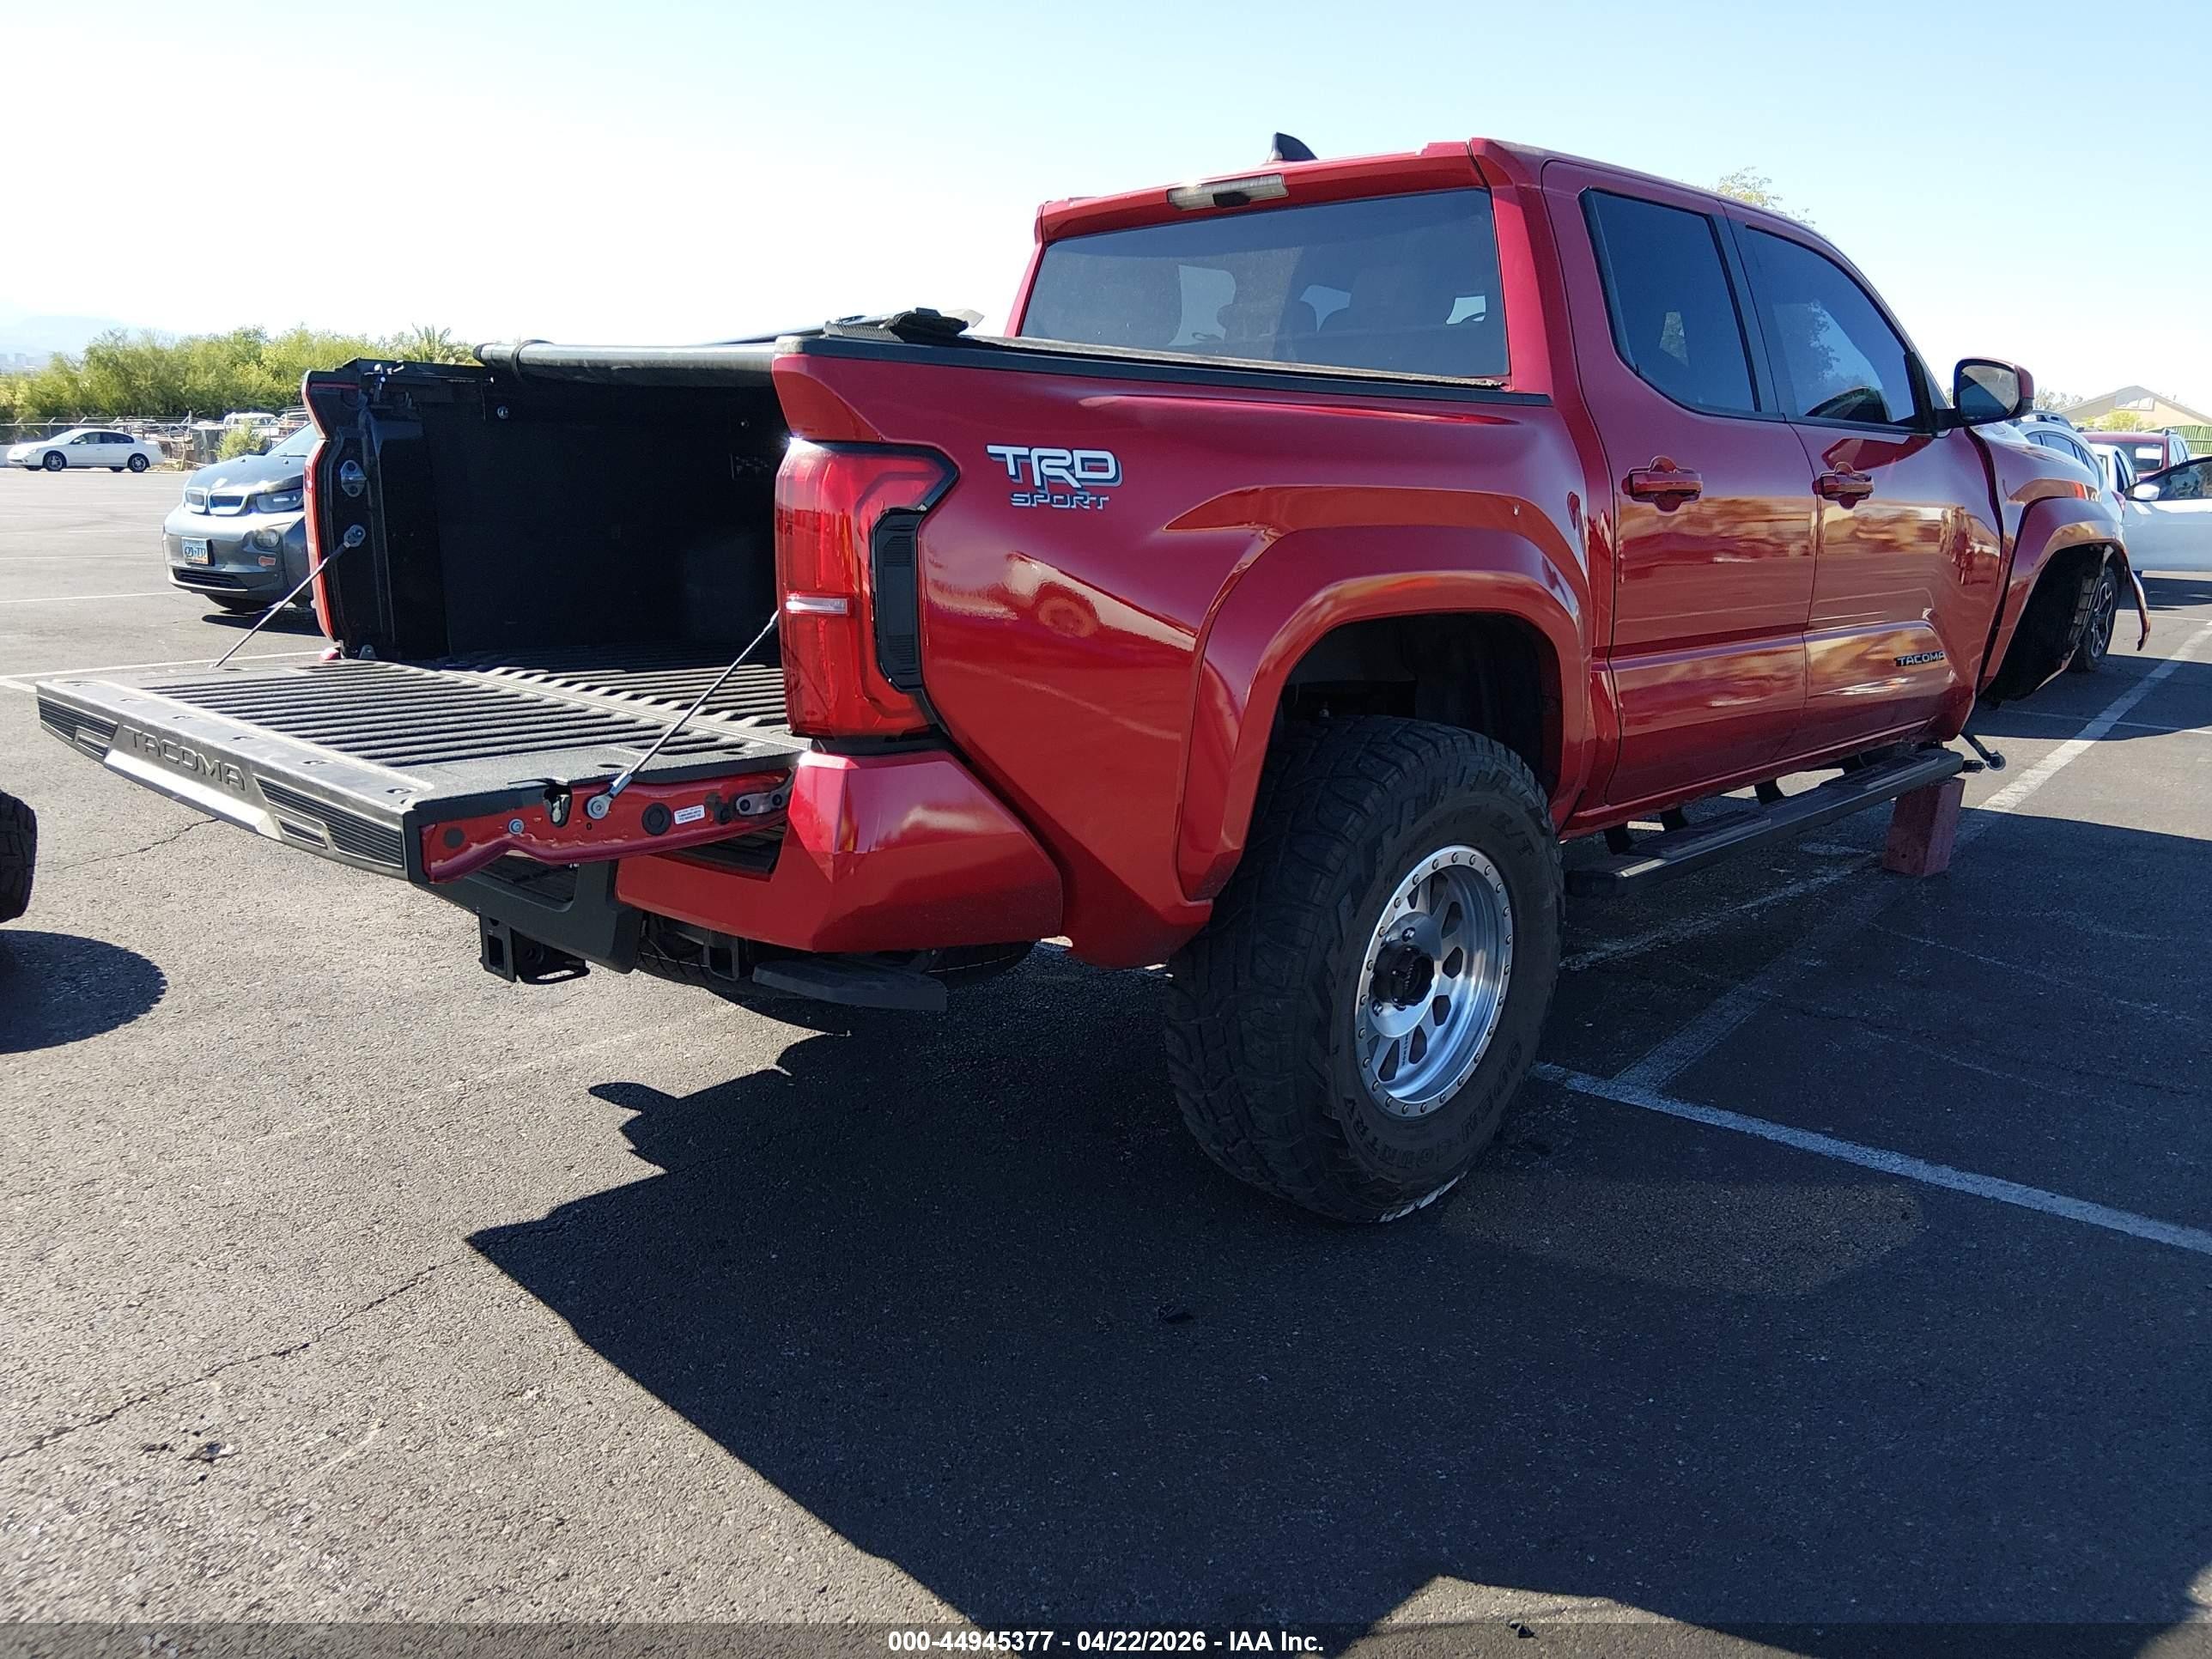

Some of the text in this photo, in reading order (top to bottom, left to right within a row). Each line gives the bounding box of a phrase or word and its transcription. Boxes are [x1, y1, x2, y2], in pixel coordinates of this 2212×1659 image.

[986, 444, 1121, 489] TRD
[1011, 492, 1109, 510] SPORT
[1896, 651, 1946, 667] TACOMA
[123, 725, 246, 791] TACOMA
